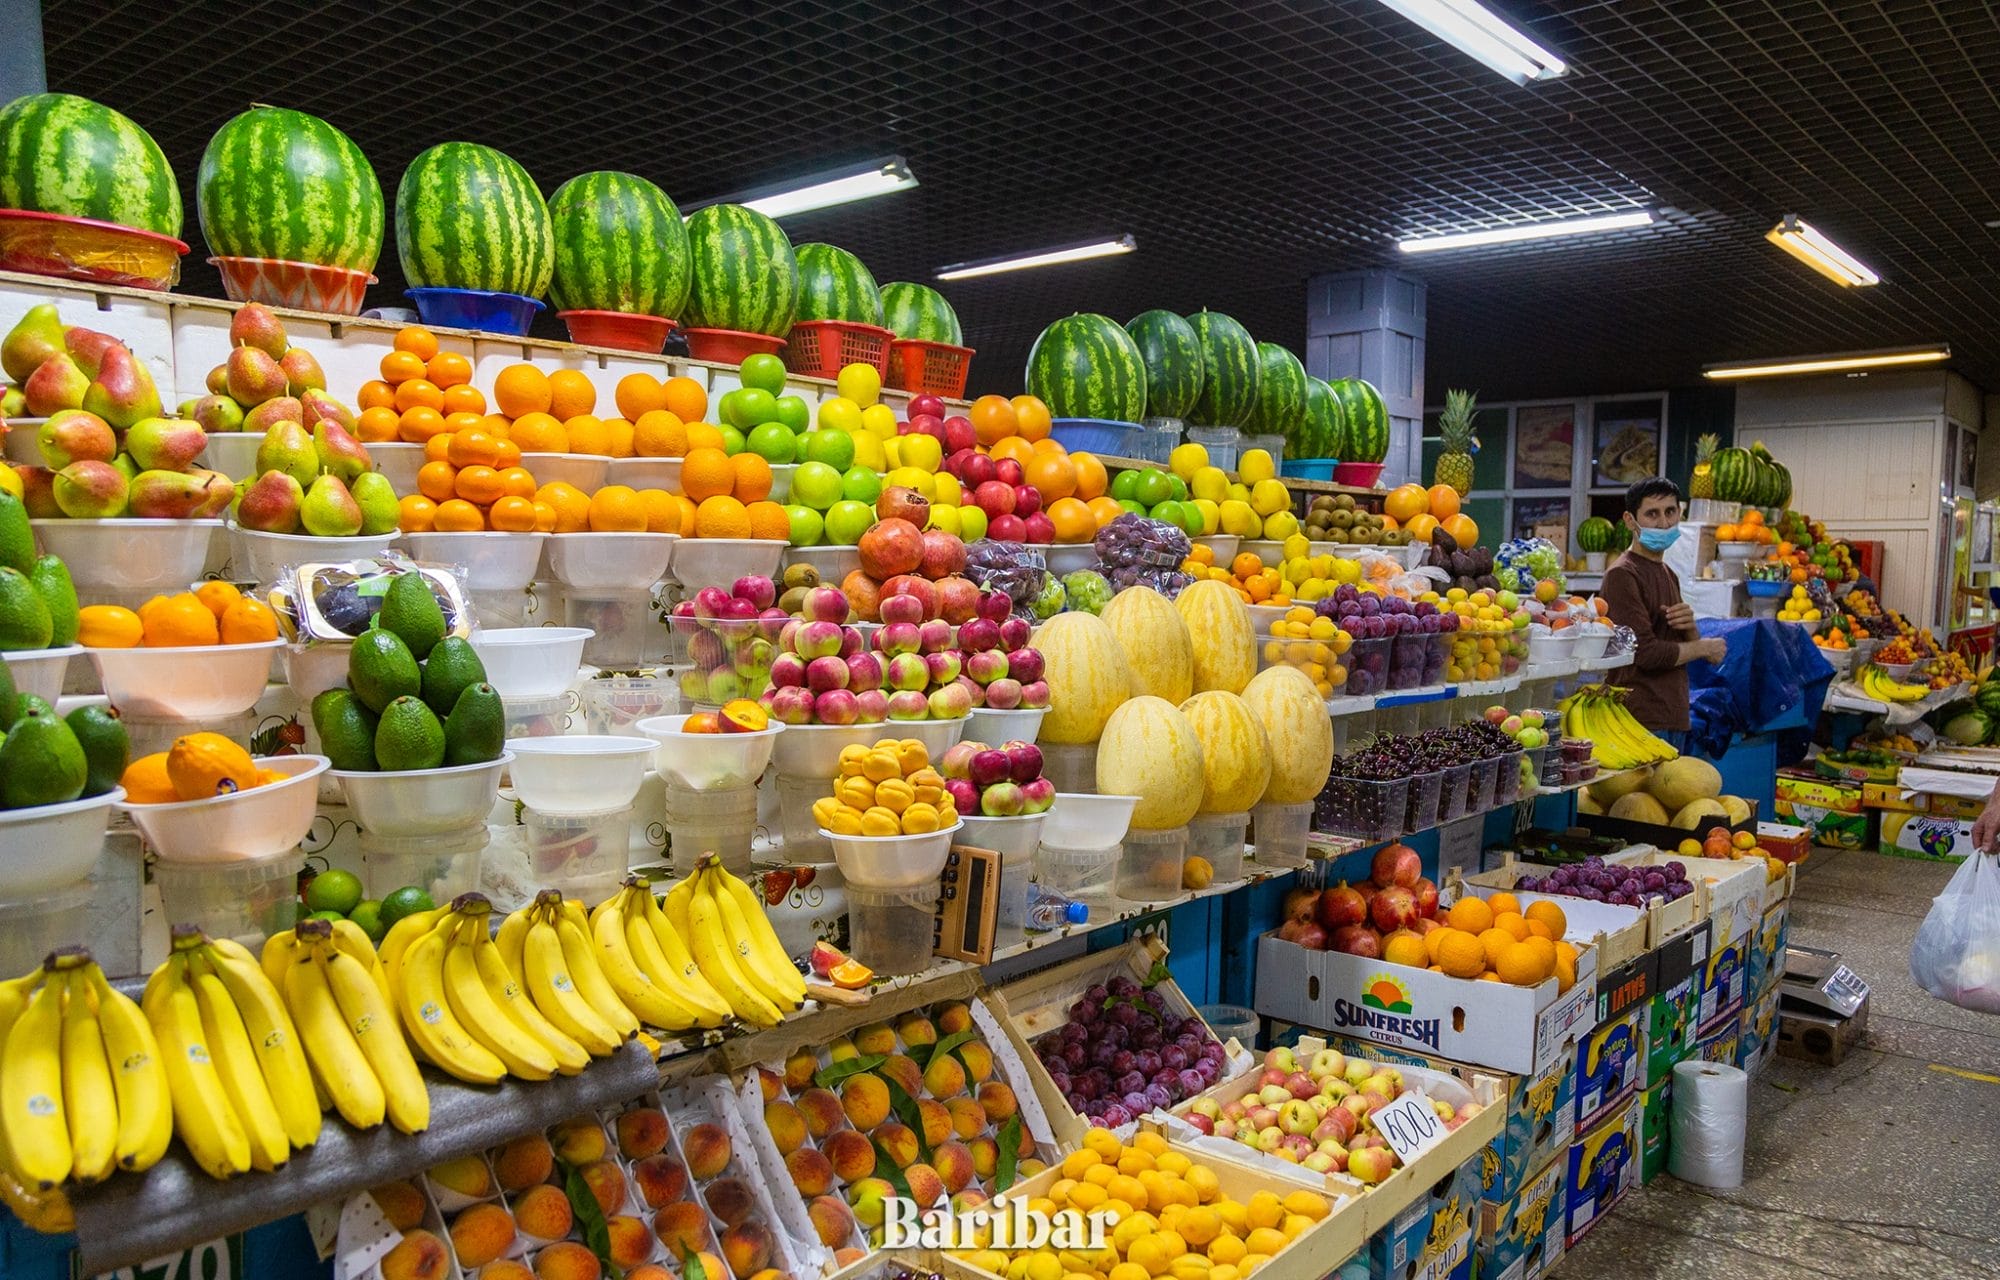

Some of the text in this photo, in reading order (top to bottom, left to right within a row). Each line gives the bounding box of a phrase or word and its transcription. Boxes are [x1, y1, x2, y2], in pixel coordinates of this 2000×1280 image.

[1612, 972, 1646, 1013] SALVI
[1334, 998, 1440, 1051] SUNFRESH
[1369, 1030, 1403, 1045] CITRUS
